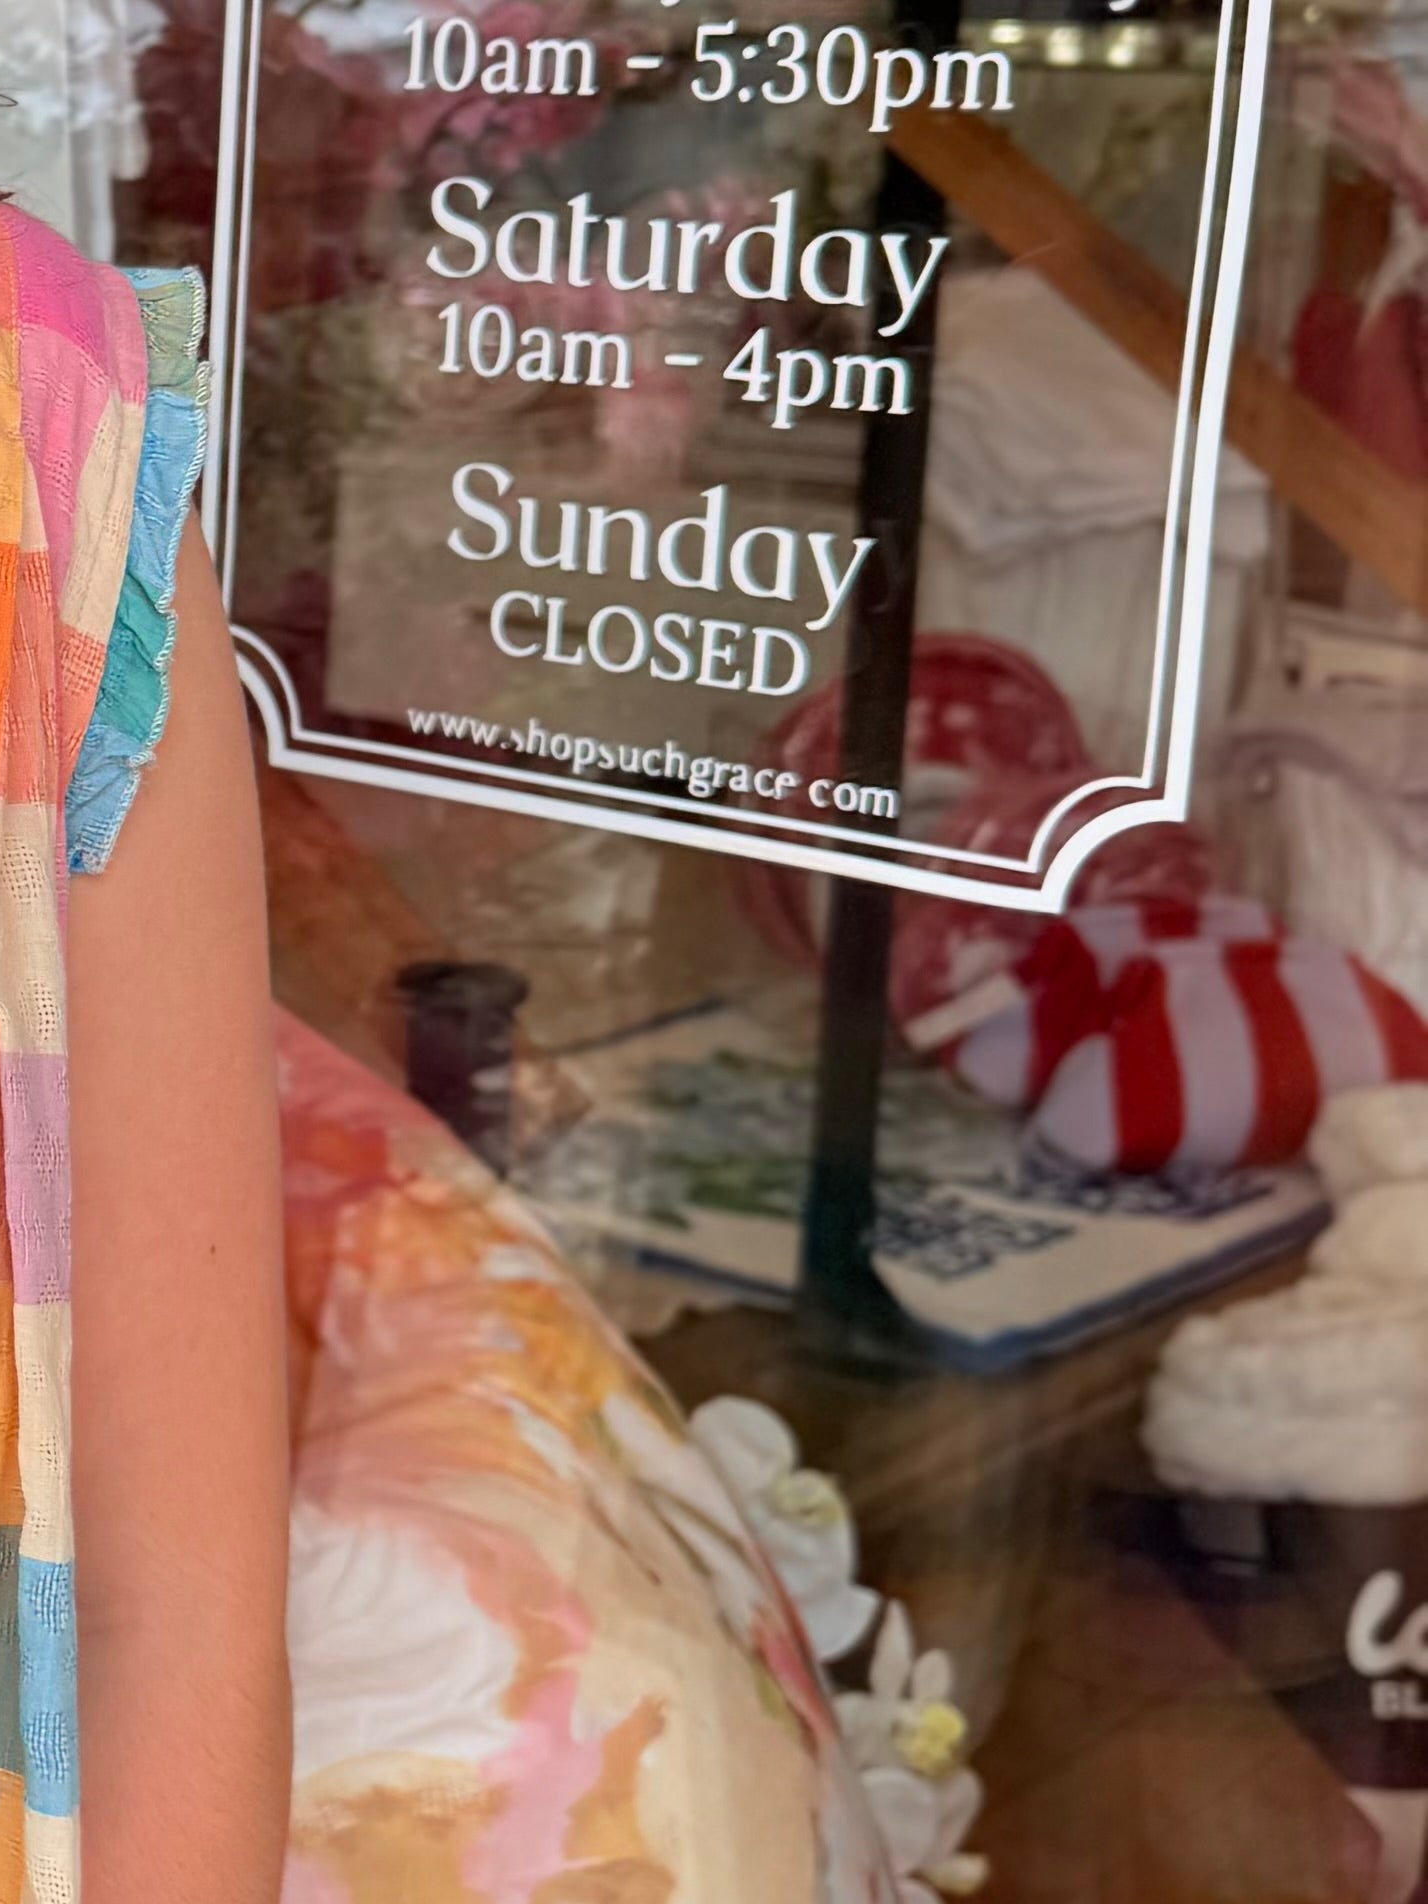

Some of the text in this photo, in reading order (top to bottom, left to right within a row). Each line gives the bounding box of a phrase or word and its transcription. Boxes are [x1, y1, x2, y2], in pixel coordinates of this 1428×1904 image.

[403, 17, 597, 96] 10am
[691, 19, 1015, 133] 5:30pm
[427, 177, 949, 337] Saturday
[437, 303, 634, 390] 10am
[723, 328, 915, 429] 4pm
[447, 463, 878, 630] Sunday
[489, 590, 812, 696] CLOSED
[407, 708, 901, 818] www.shopsuchgracecom
